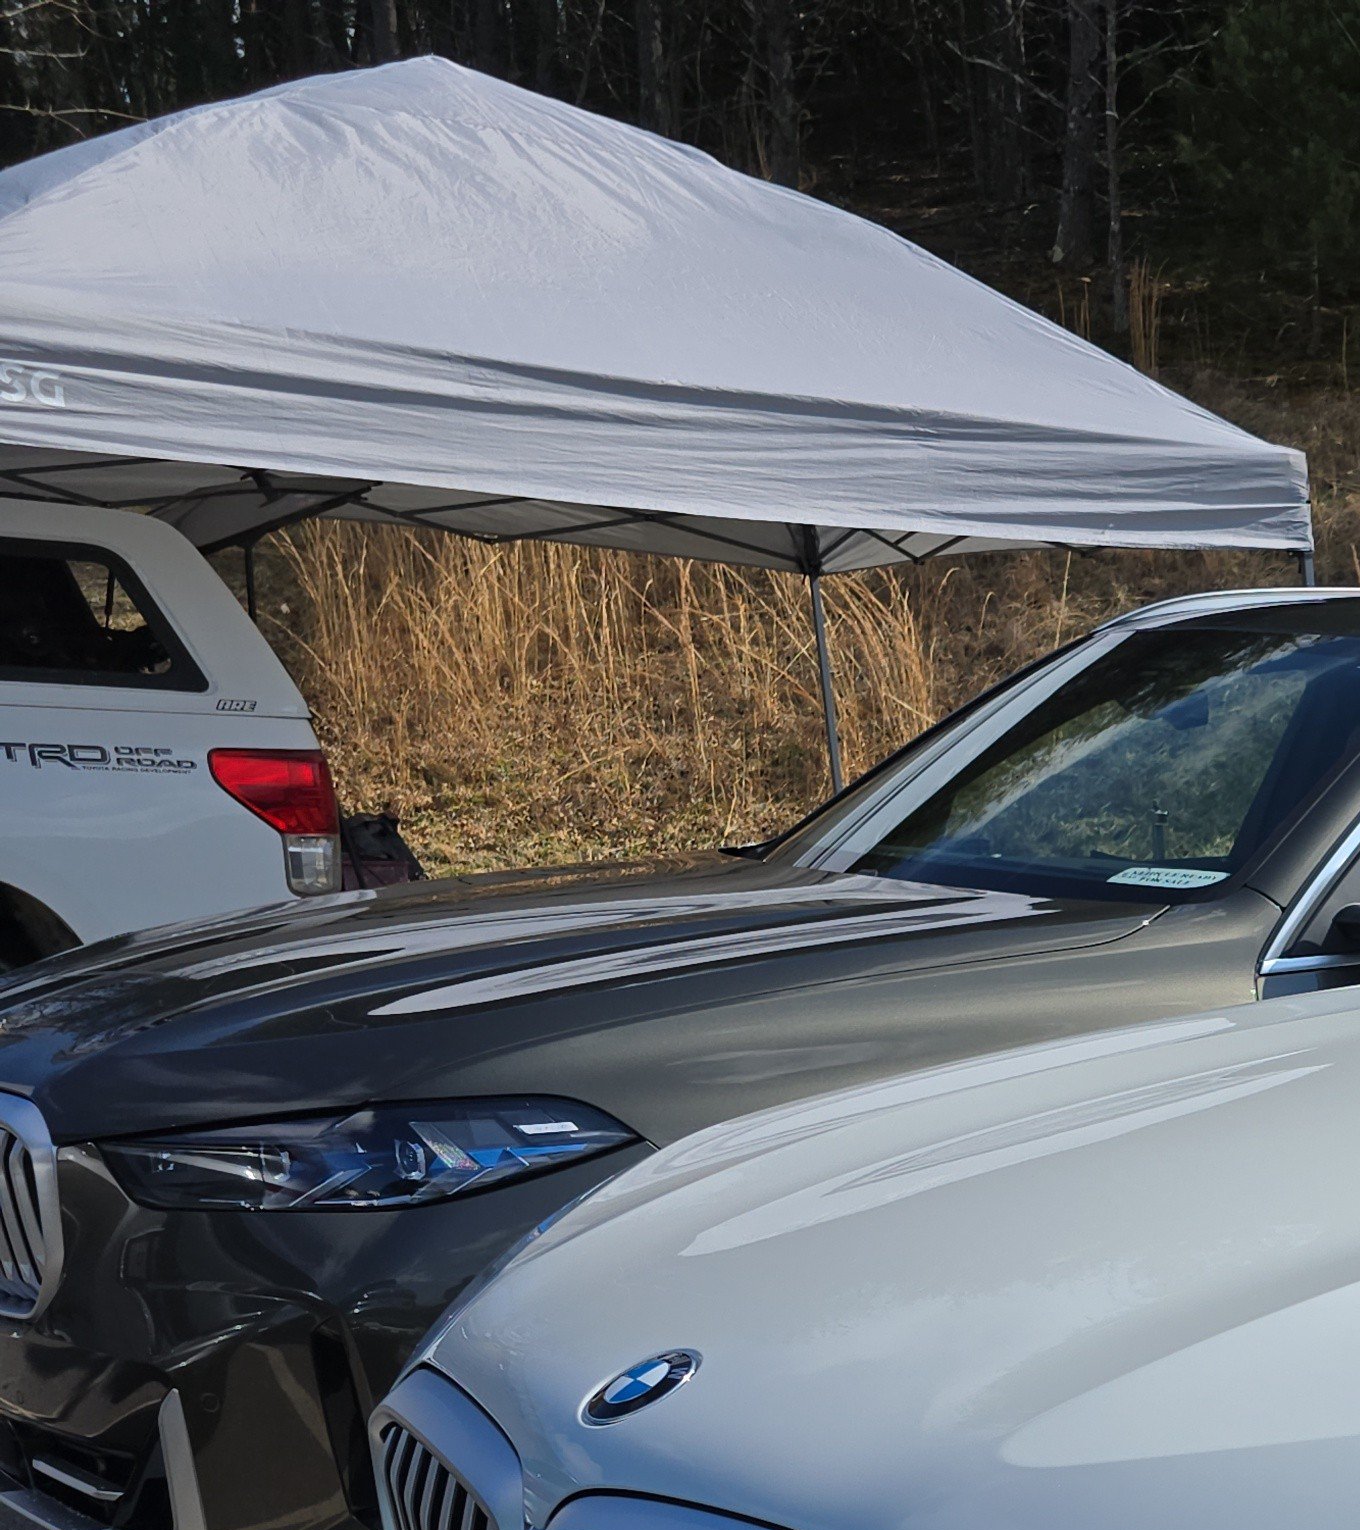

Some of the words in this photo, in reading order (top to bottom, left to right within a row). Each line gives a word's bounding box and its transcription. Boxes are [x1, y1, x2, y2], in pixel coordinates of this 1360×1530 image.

[0, 742, 111, 771] TRD
[114, 746, 173, 757] OFF
[116, 757, 197, 769] ROAD
